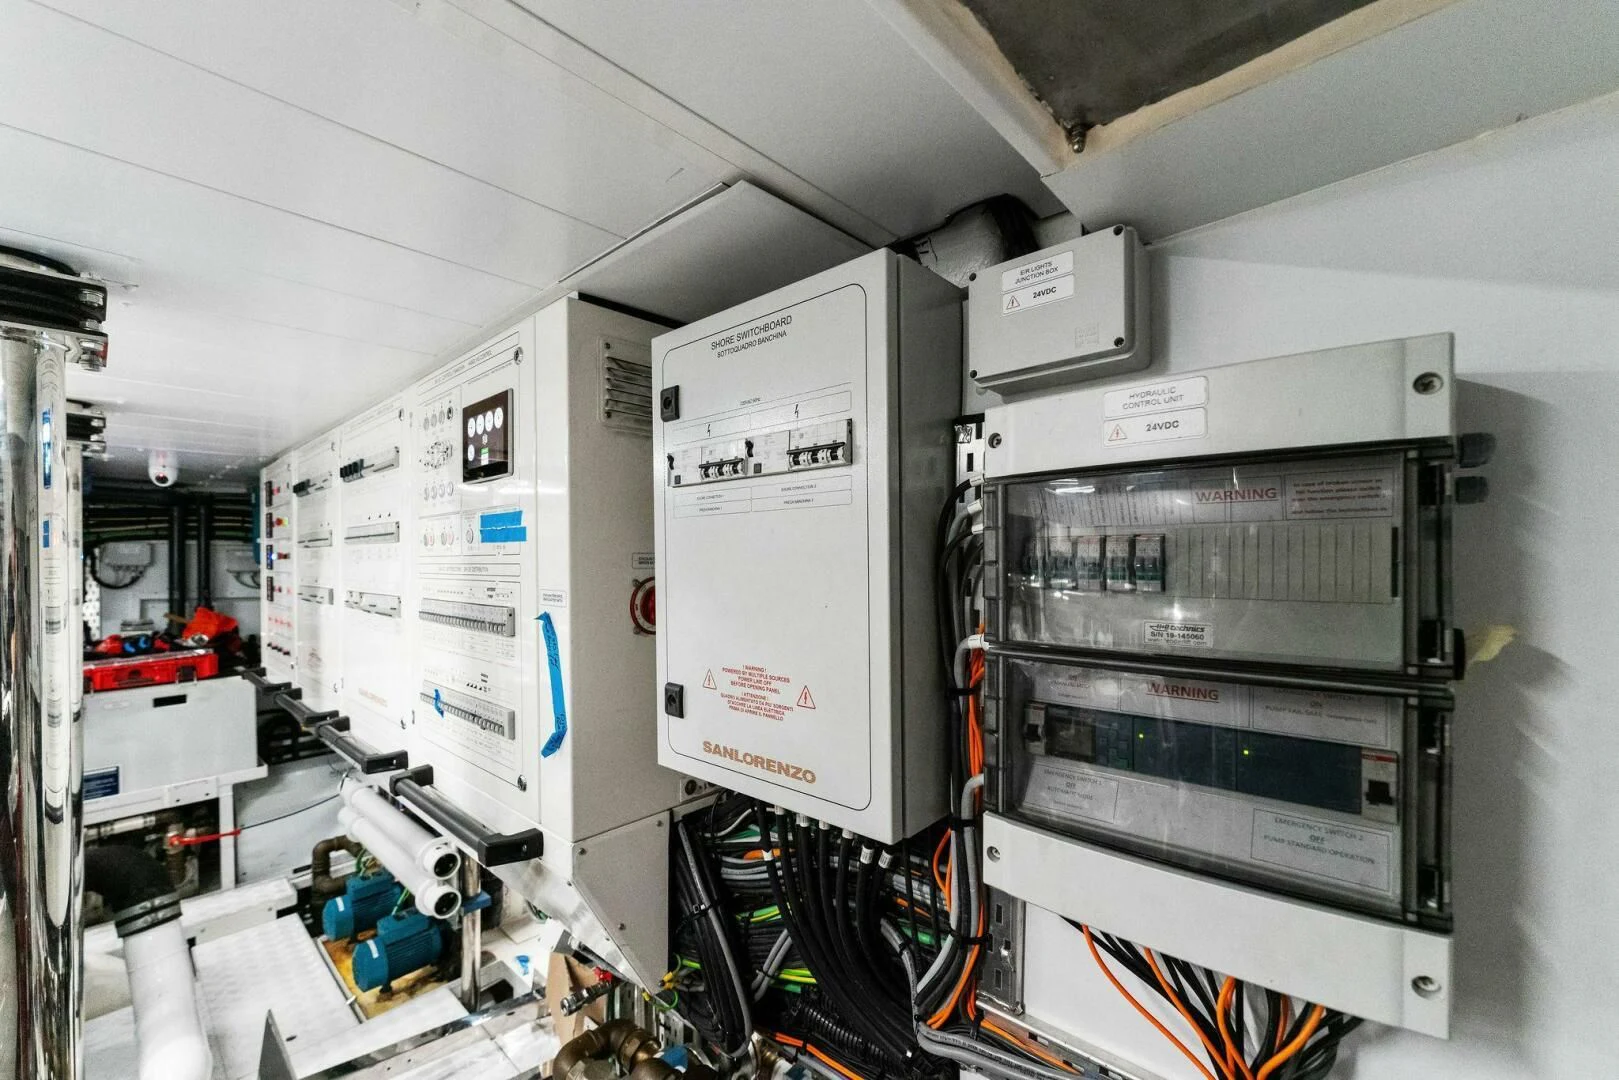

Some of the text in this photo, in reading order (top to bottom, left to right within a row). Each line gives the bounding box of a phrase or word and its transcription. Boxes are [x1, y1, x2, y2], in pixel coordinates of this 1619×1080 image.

[1015, 266, 1059, 284] JUNCTION BOX
[1030, 262, 1053, 272] LIGHTS
[1032, 286, 1057, 299] 24VDC
[711, 315, 792, 350] SHORE SWITCHBOARD
[717, 330, 788, 358] SOTTOQUADRO BANCHINA
[1129, 386, 1176, 399] HYDRAULIC
[1122, 394, 1184, 410] CONTROL UNIT
[1146, 420, 1180, 432] 24VDC
[1196, 487, 1278, 502] WARNING
[1146, 682, 1220, 701] WARNING
[702, 740, 817, 784] SANLORENZO
[1274, 817, 1321, 832] EMERGENCY
[1325, 827, 1357, 840] SWITCH
[1309, 835, 1325, 845] OFF
[1264, 834, 1375, 864] PUMP STANDARD OPERATION
